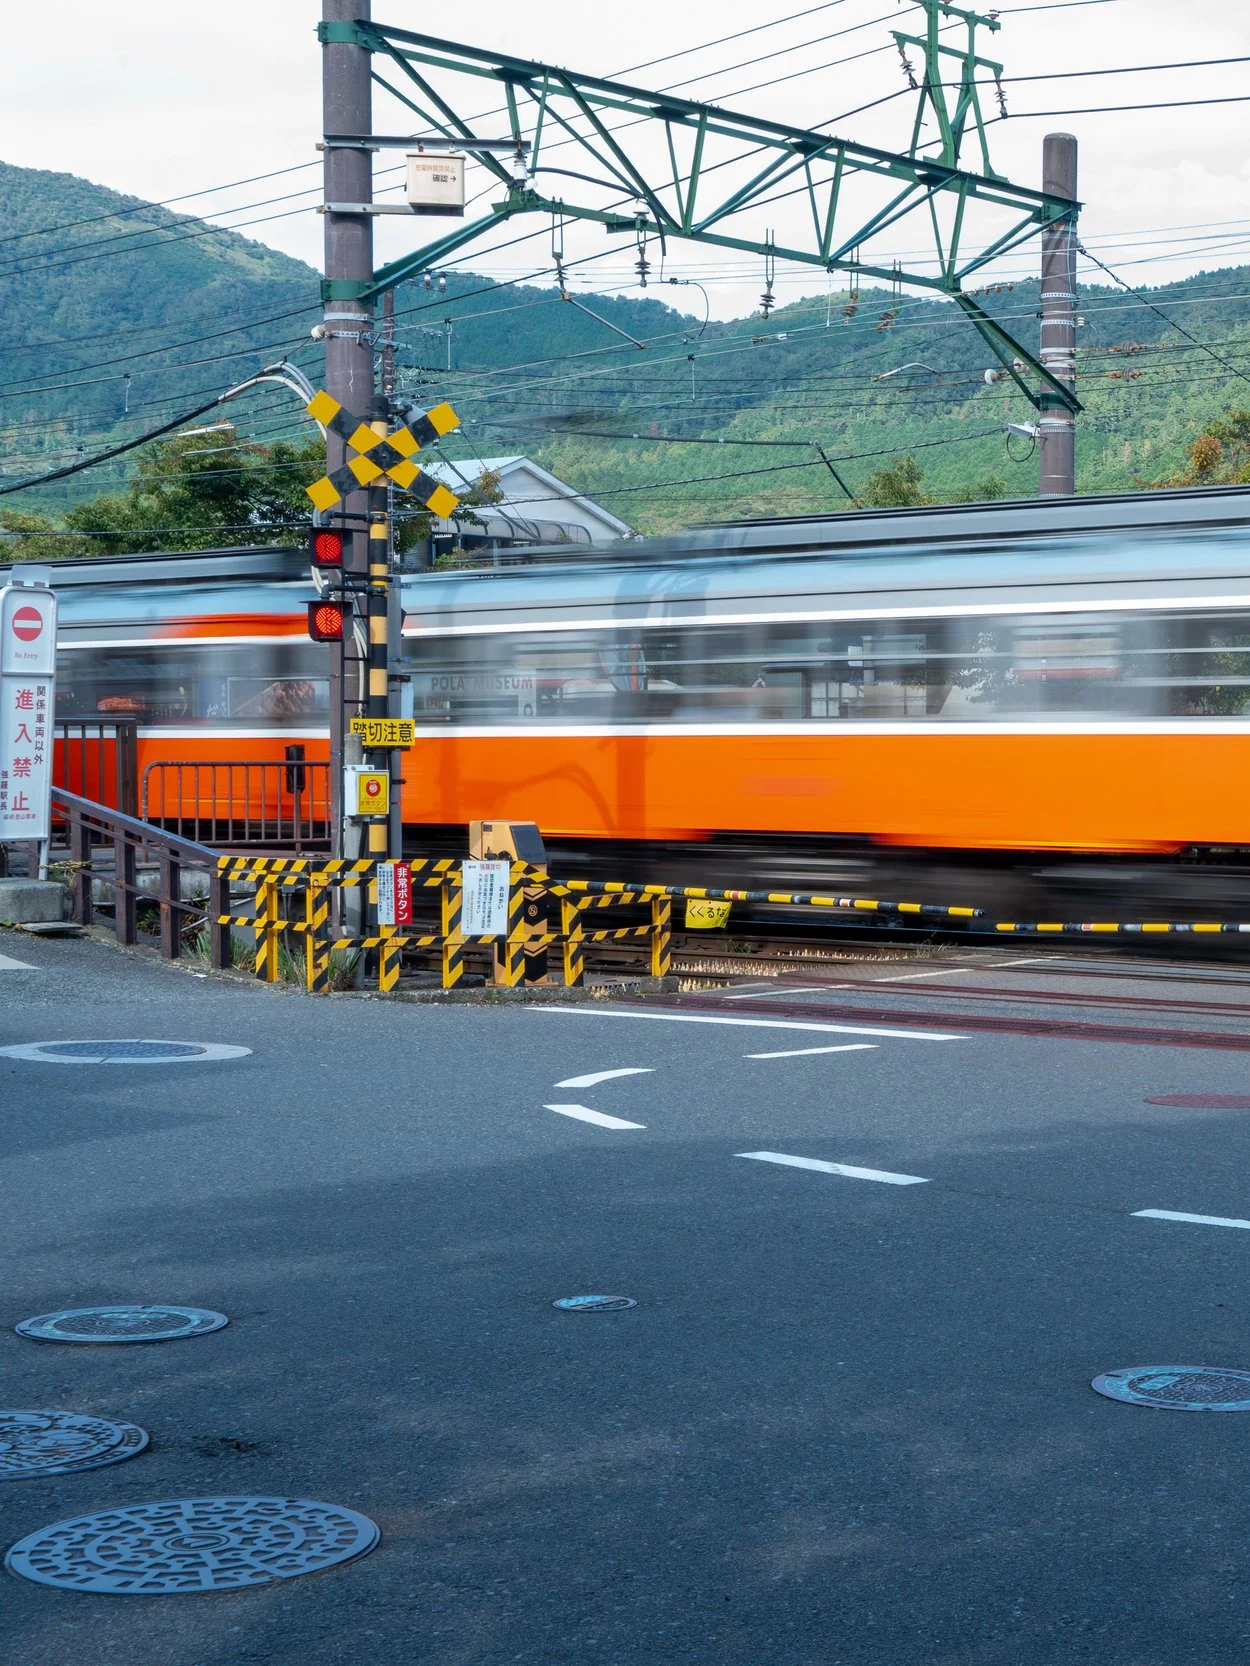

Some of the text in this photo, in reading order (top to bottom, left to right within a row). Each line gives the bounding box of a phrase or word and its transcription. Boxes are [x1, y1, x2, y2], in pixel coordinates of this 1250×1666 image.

[23, 652, 38, 660] Entry
[431, 676, 465, 692] POLA
[34, 686, 46, 765] 関係車両以外
[353, 722, 413, 743] 踏切注意
[11, 689, 34, 811] 進入禁止
[397, 867, 408, 920] 非常ボタン
